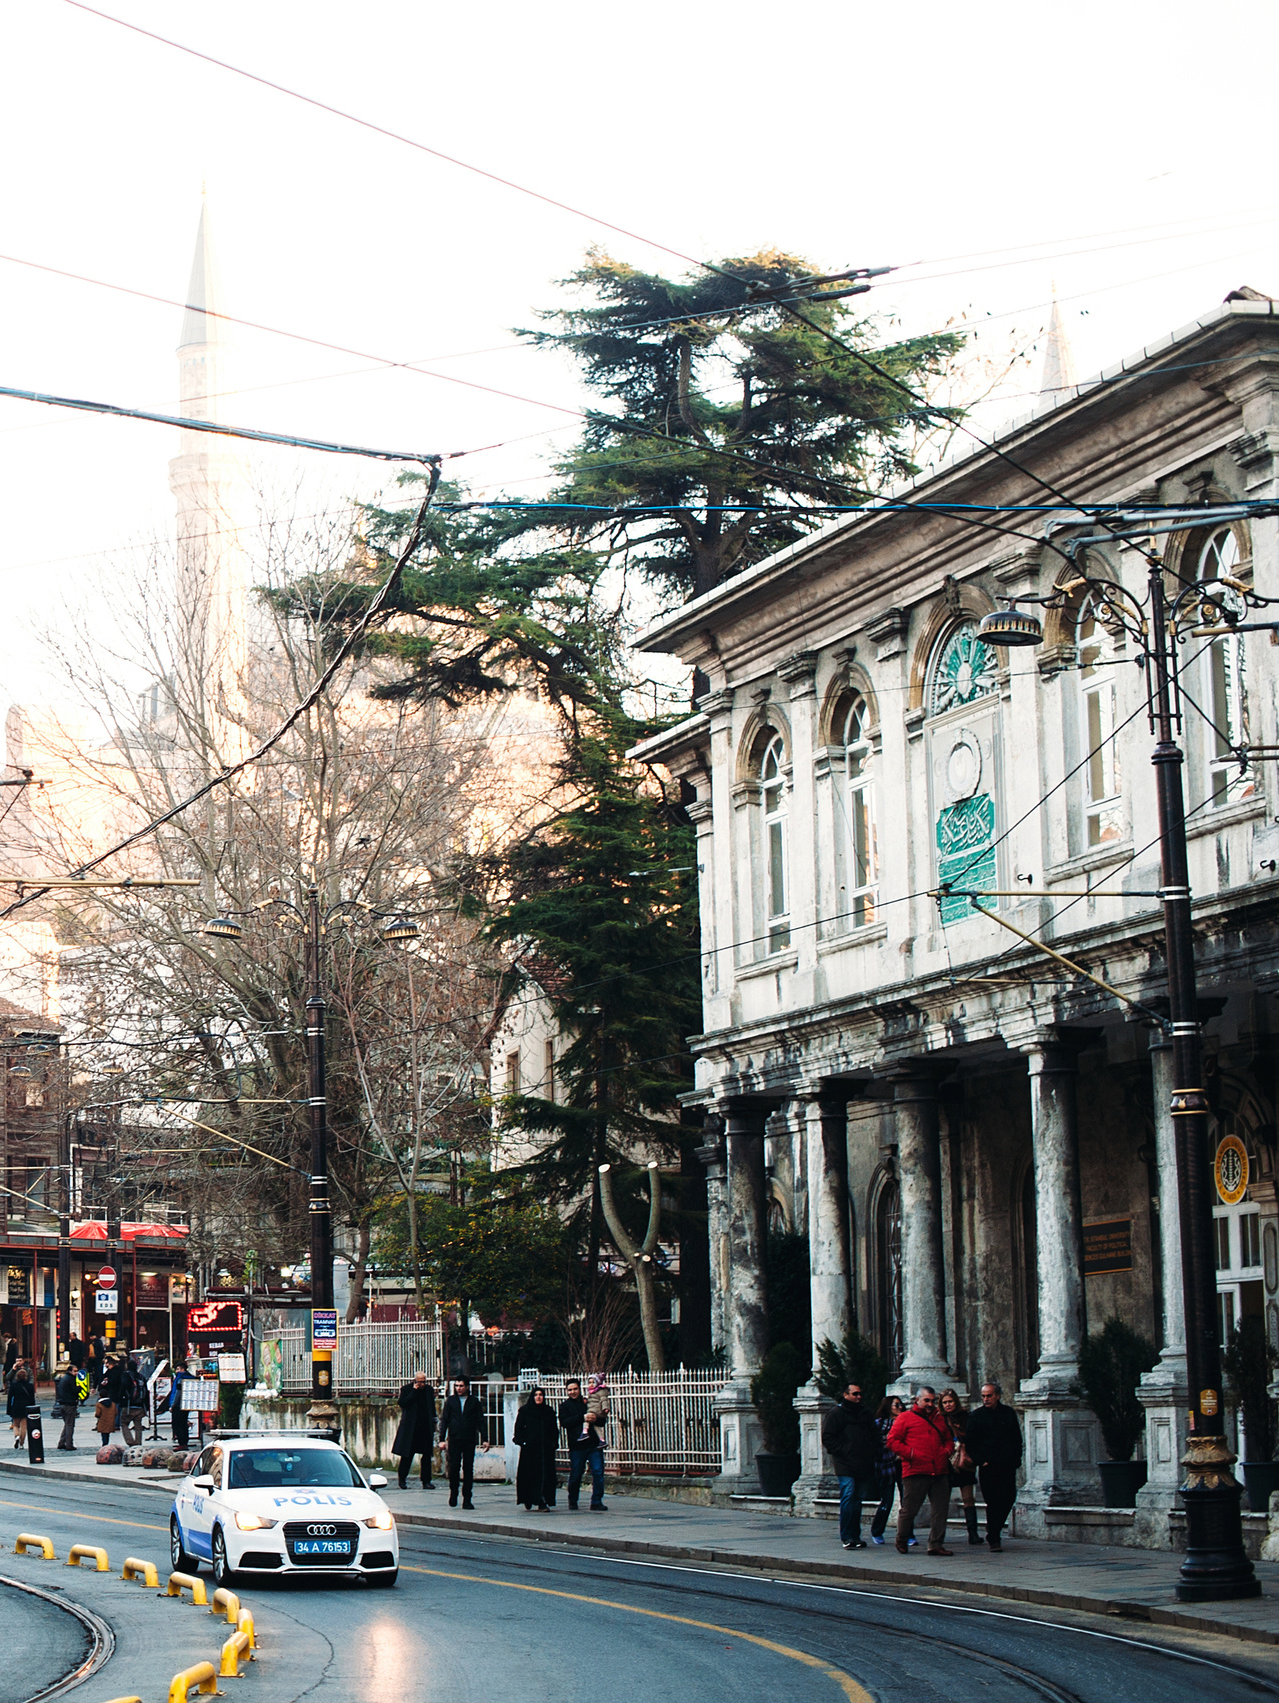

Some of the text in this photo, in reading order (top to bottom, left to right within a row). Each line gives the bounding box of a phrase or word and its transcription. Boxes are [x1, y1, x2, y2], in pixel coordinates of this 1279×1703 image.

[272, 1494, 353, 1507] POLİS
[297, 1541, 349, 1552] 34 A 76153
